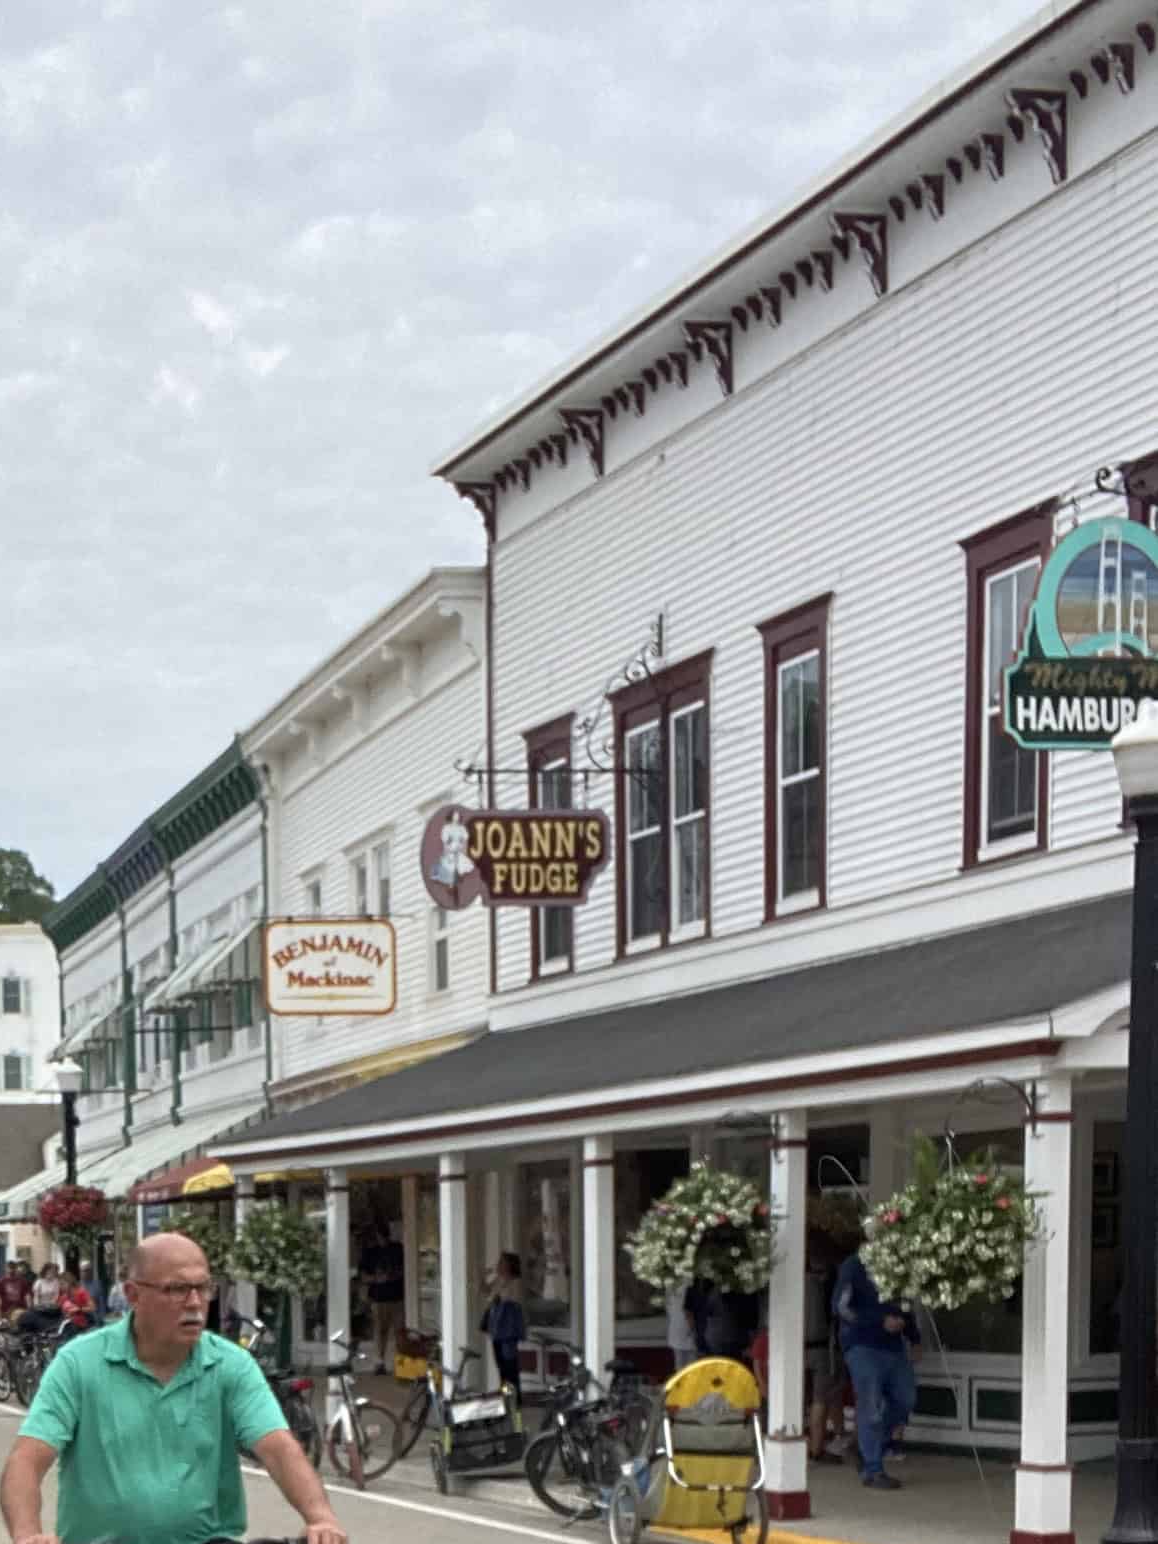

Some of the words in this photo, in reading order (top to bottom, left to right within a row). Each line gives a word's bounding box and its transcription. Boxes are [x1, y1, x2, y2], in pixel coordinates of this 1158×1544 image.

[1024, 662, 1127, 695] Mighty
[470, 820, 601, 859] JOANN'S
[493, 862, 579, 894] FUDGE
[272, 934, 389, 968] BENJAMIN
[287, 971, 374, 988] Mackinac
